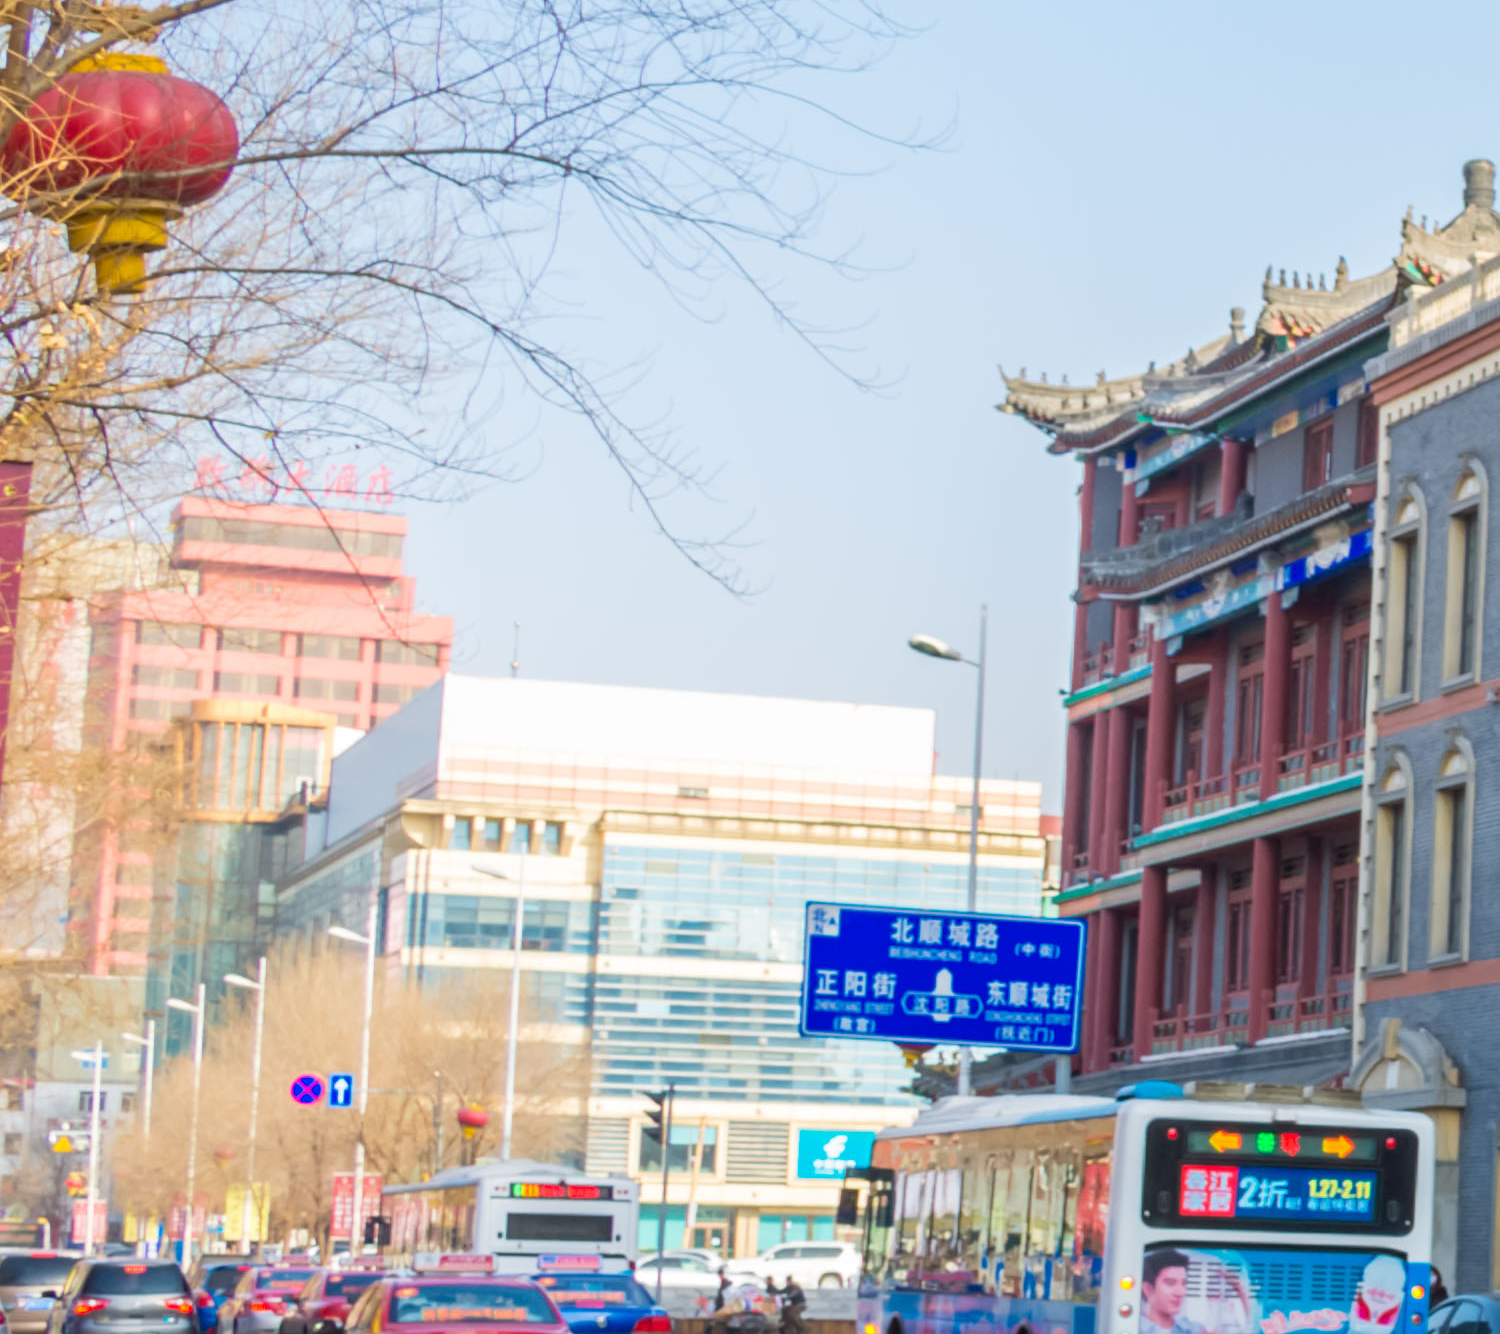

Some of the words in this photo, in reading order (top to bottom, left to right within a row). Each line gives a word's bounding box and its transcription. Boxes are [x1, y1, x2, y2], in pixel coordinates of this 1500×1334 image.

[890, 918, 999, 949] 北顺城路
[815, 969, 897, 999] 正阳街
[986, 981, 1073, 1011] 东顺城街
[913, 997, 970, 1015] 沈阳路
[1308, 1179, 1371, 1199] 1.27-2.11
